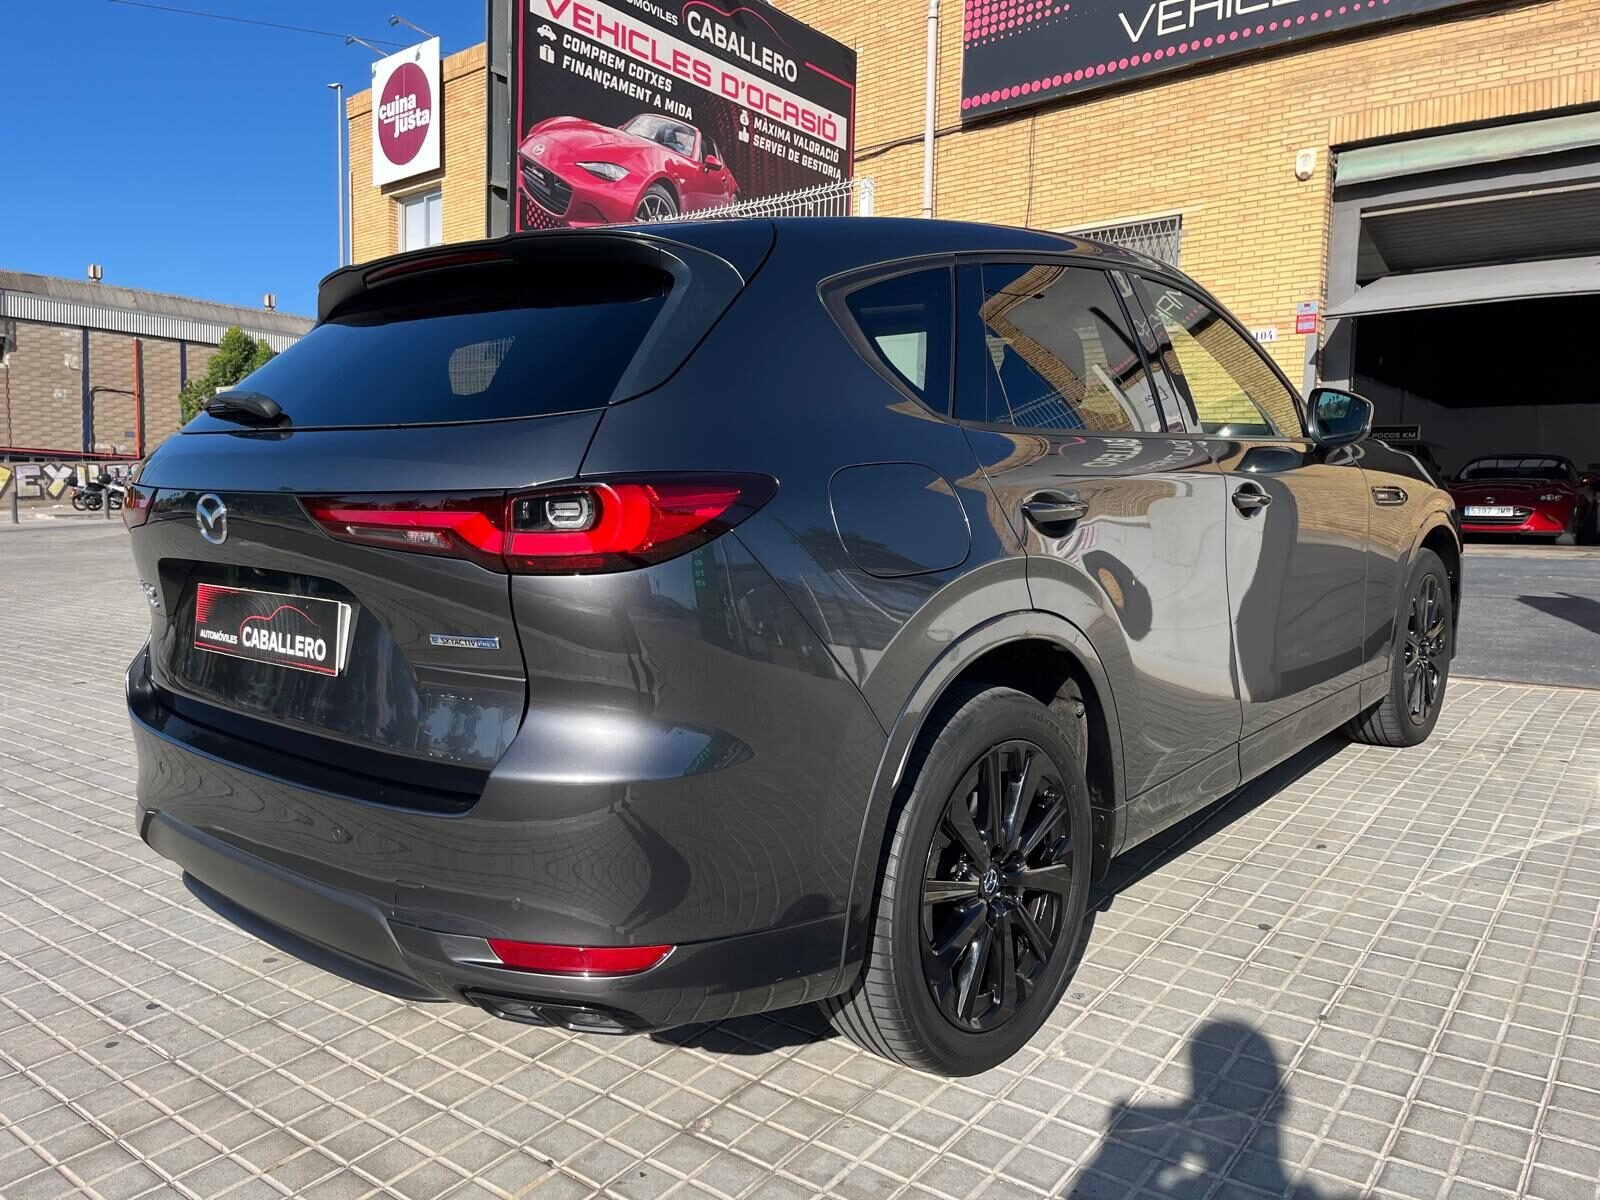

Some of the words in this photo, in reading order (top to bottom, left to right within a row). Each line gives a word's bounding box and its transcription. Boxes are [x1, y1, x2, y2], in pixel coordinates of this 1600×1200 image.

[562, 34, 625, 72] COMPREM
[628, 63, 673, 92] COTXES
[687, 10, 798, 82] CABALLERO
[545, 0, 712, 87] VEHICLES
[721, 71, 837, 142] D'OCASIÓ
[562, 55, 652, 103] FINANÇAMENT
[653, 94, 662, 108] A
[664, 99, 693, 120] MIDA
[379, 93, 417, 120] cuina
[393, 108, 430, 139] justa
[753, 117, 791, 143] MÀXIMA
[793, 133, 840, 163] VALORACIÓ
[753, 134, 786, 158] SERVEI
[787, 148, 800, 163] DE
[801, 155, 842, 180] GESTORIA
[200, 629, 238, 644] AUTOMÓVILES
[242, 626, 327, 662] CABALLERO
